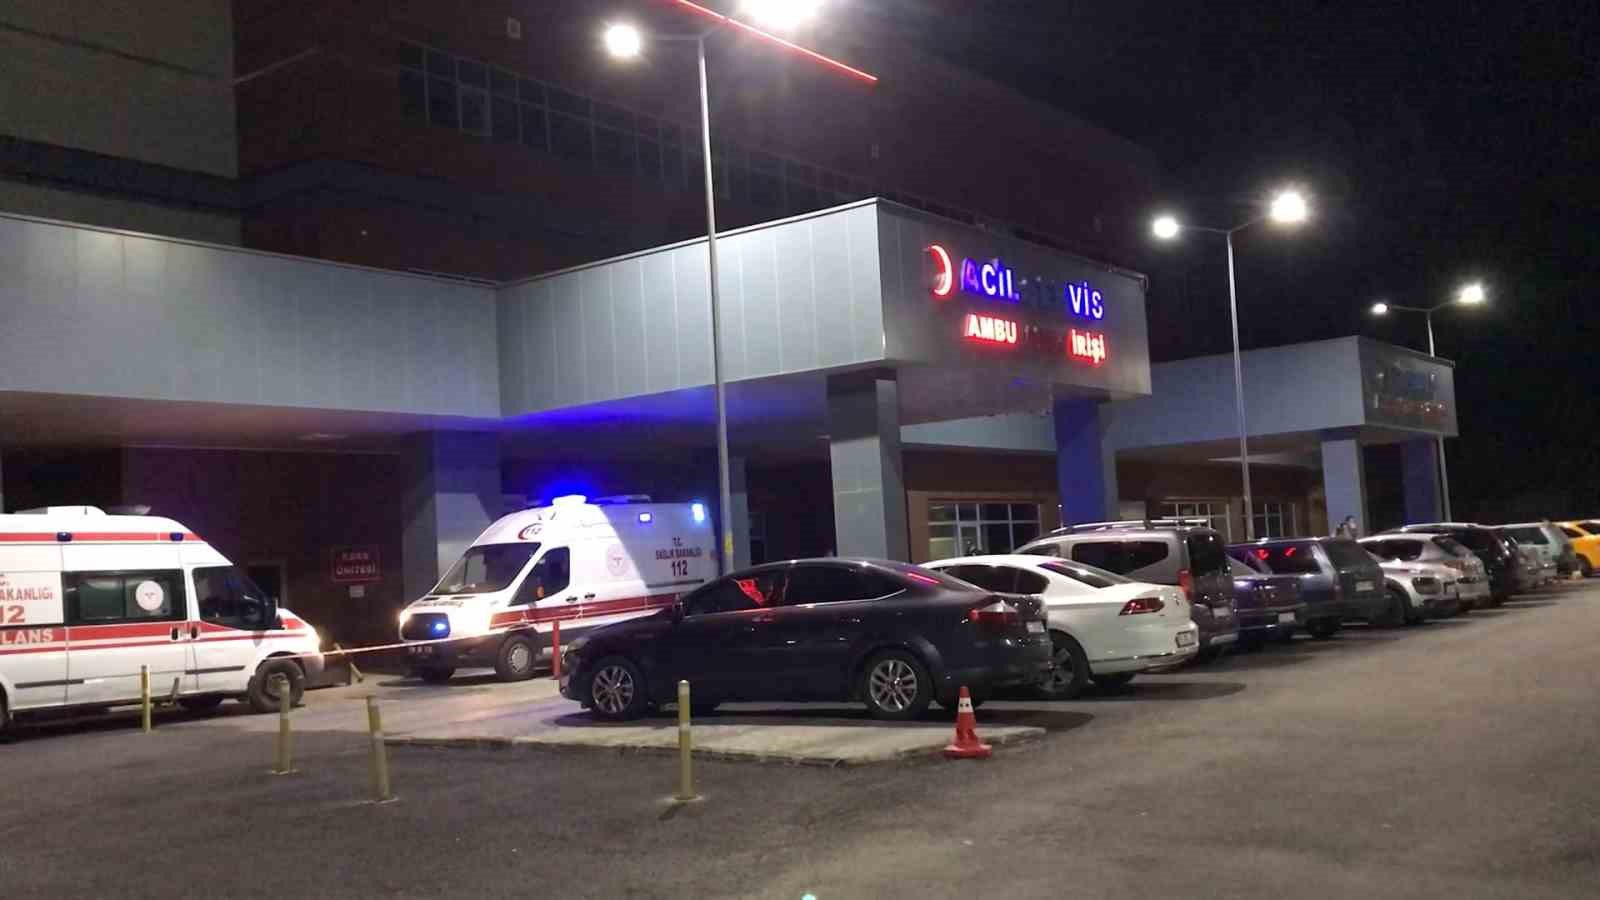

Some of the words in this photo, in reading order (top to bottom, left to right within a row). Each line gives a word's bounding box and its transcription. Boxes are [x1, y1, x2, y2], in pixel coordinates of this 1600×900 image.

[1067, 281, 1104, 319] VİS
[964, 313, 1017, 344] AMBU
[1070, 328, 1106, 363] İRİŞİ
[671, 560, 688, 576] 112
[0, 586, 53, 601] AKANLIĞI
[0, 605, 26, 624] 12
[1, 628, 54, 645] LANS
